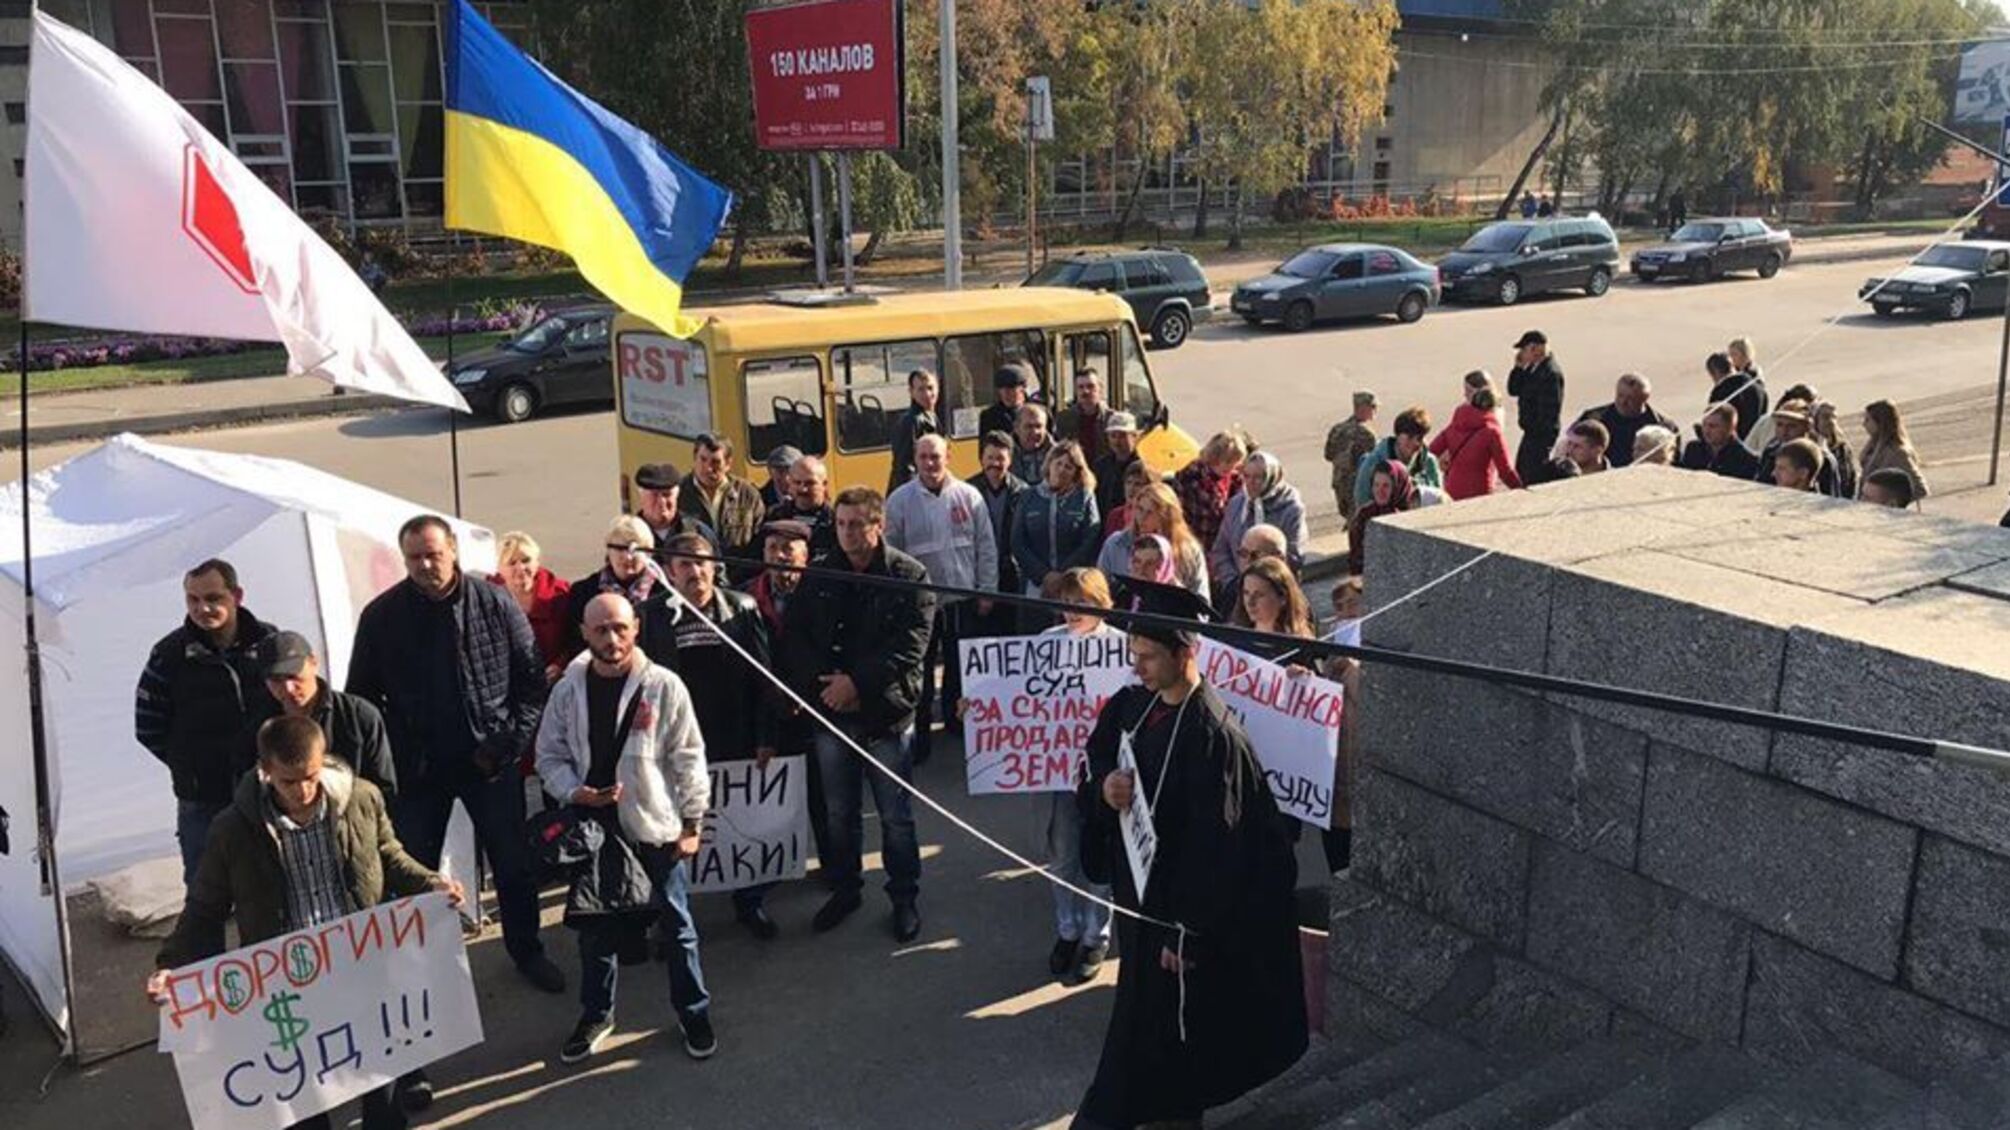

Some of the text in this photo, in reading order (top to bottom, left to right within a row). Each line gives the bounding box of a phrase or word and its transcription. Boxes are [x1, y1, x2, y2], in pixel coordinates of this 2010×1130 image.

[770, 44, 875, 77] 150 КАНАЛОВ
[1025, 672, 1086, 697] СУД
[972, 698, 1003, 723] ЗА
[168, 899, 425, 1028] ДОРОГИЙ
[224, 1022, 362, 1107] СУД
